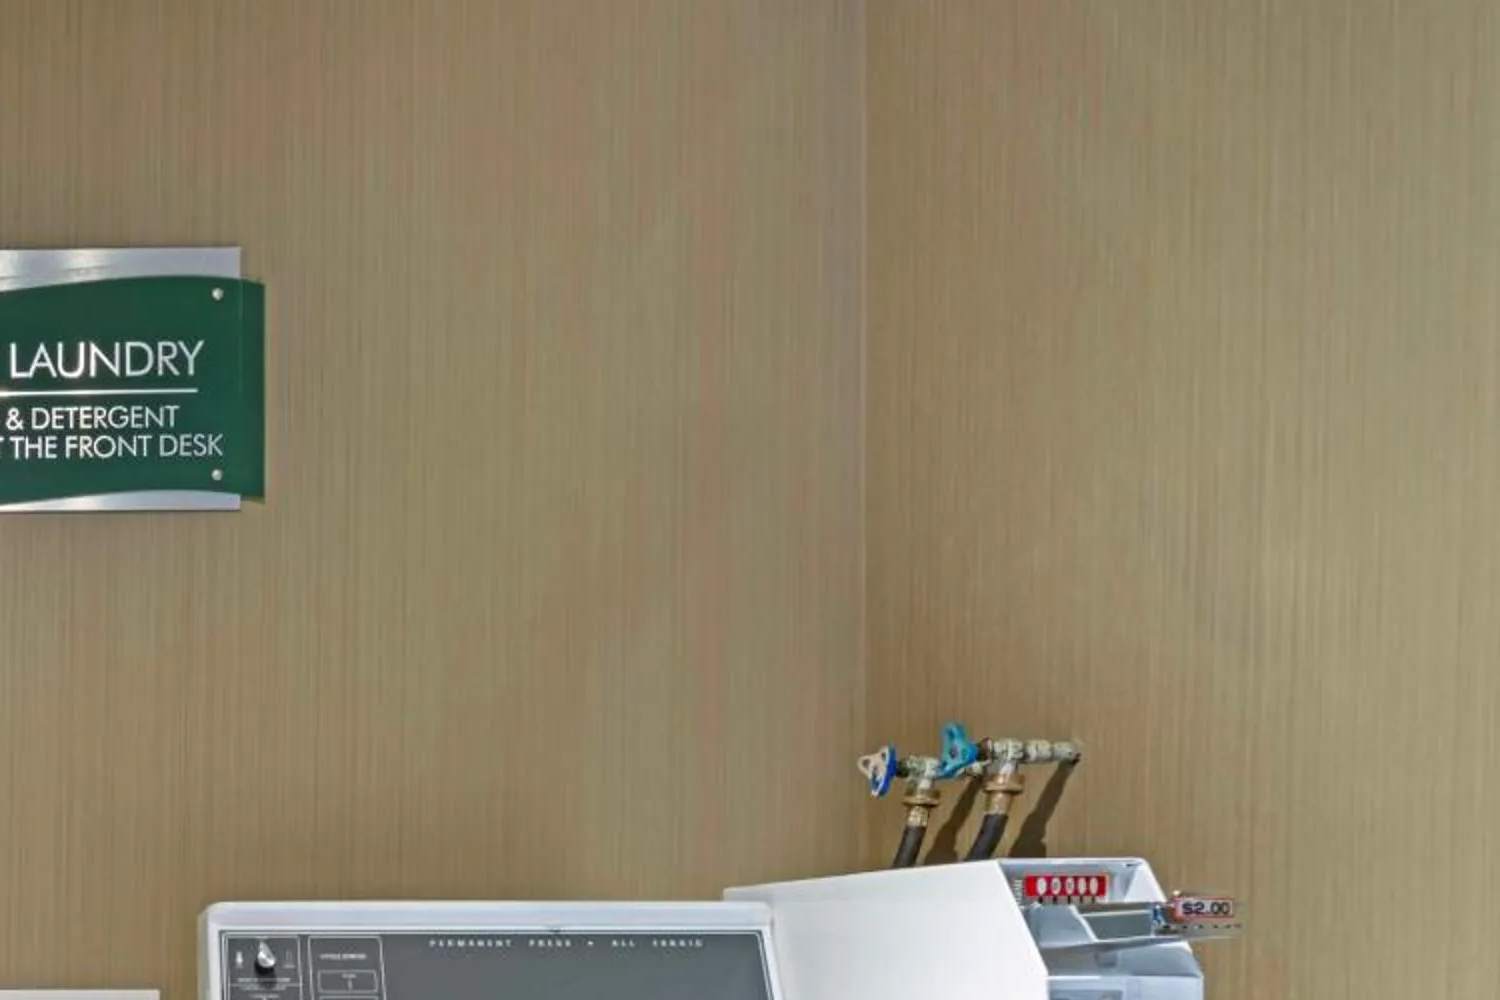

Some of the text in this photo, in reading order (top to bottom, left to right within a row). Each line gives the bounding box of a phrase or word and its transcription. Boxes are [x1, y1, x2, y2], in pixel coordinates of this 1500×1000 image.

[10, 340, 204, 379] LAUNDRY
[5, 407, 24, 430] &
[31, 405, 180, 430] DETERGENT
[10, 435, 57, 460] THE
[65, 435, 152, 459] FRONT
[159, 433, 224, 457] DESK
[1182, 901, 1230, 915] $2.00
